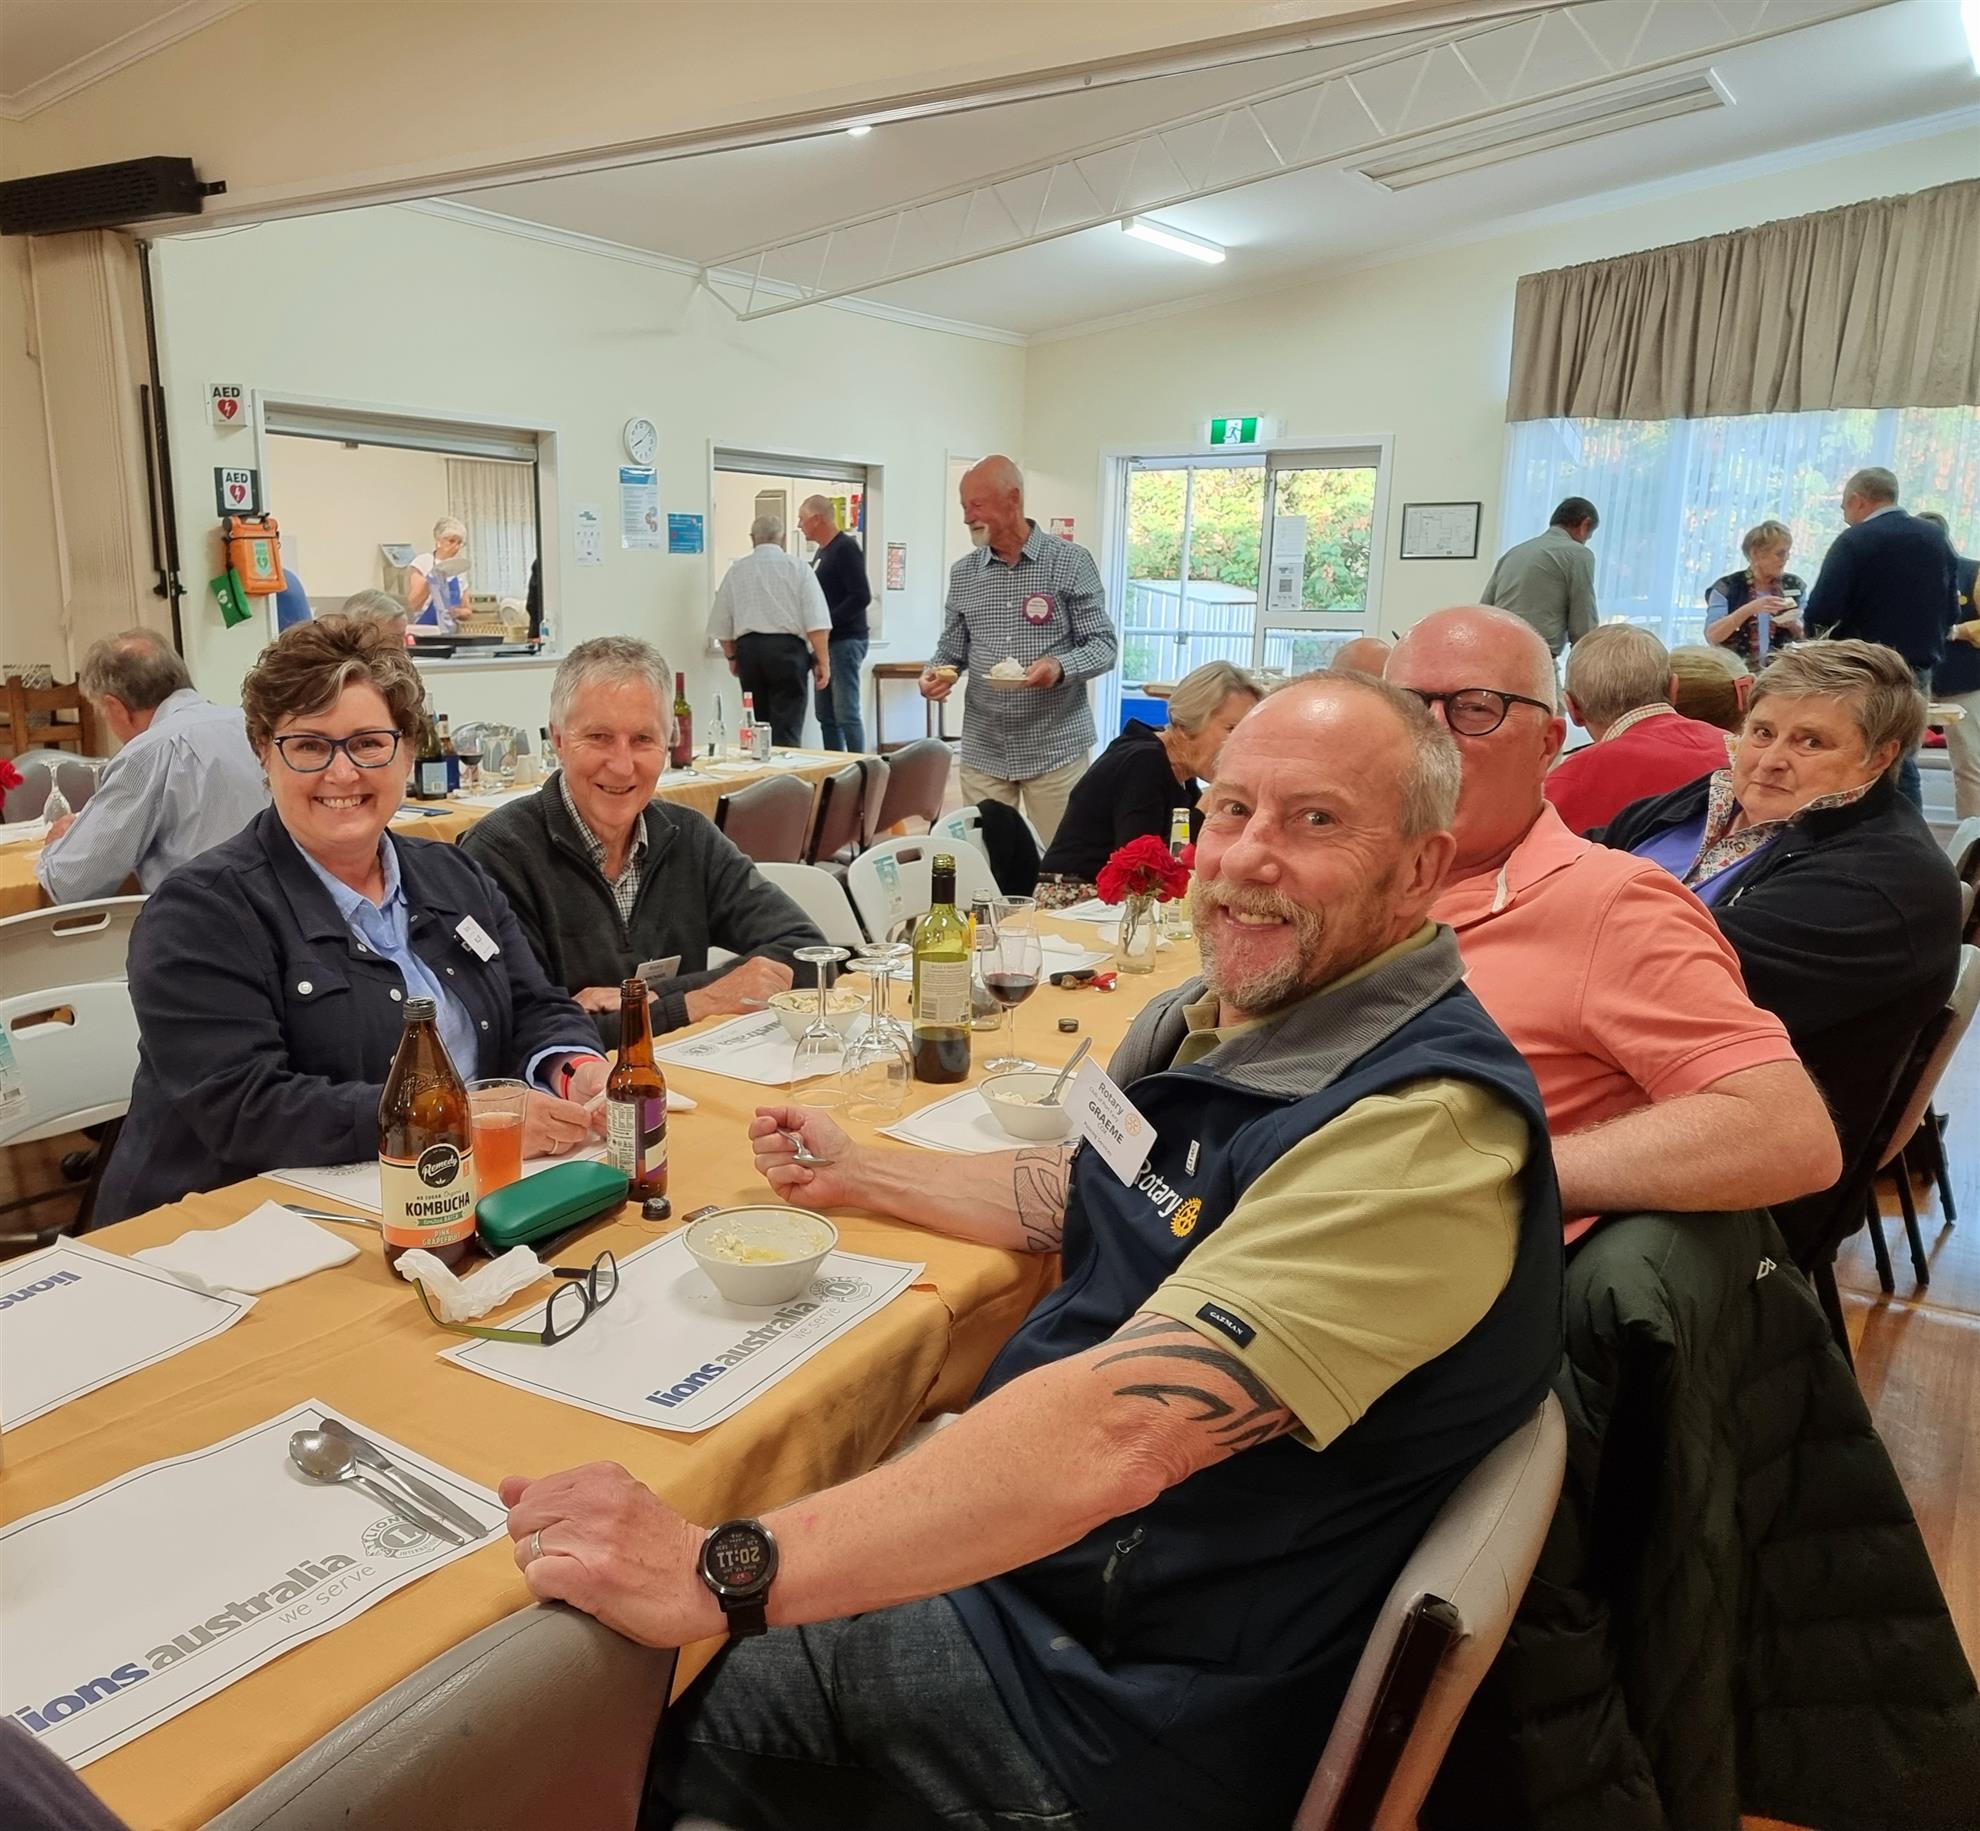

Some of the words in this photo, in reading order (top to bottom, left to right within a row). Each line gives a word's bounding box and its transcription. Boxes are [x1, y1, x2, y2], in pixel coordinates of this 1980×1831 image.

[212, 386, 241, 398] AED
[225, 471, 249, 484] AED
[1099, 1082, 1125, 1115] Rotary
[1088, 1101, 1125, 1145] GRAEME
[421, 1154, 458, 1182] Remedy
[1134, 1158, 1184, 1218] Rotary
[405, 1191, 471, 1217] KOMBUCHA
[422, 1232, 461, 1246] GRAPEFRUIT
[434, 1228, 450, 1238] PINK
[790, 1326, 812, 1340] we
[813, 1307, 841, 1329] serve
[1209, 1311, 1244, 1335] GAZMAN
[645, 1363, 728, 1408] lions
[714, 1302, 821, 1367] australia
[365, 1515, 403, 1538] LION
[716, 1546, 760, 1568] 20:11
[278, 1603, 312, 1625] we
[316, 1563, 377, 1606] serve
[145, 1554, 358, 1671] australia
